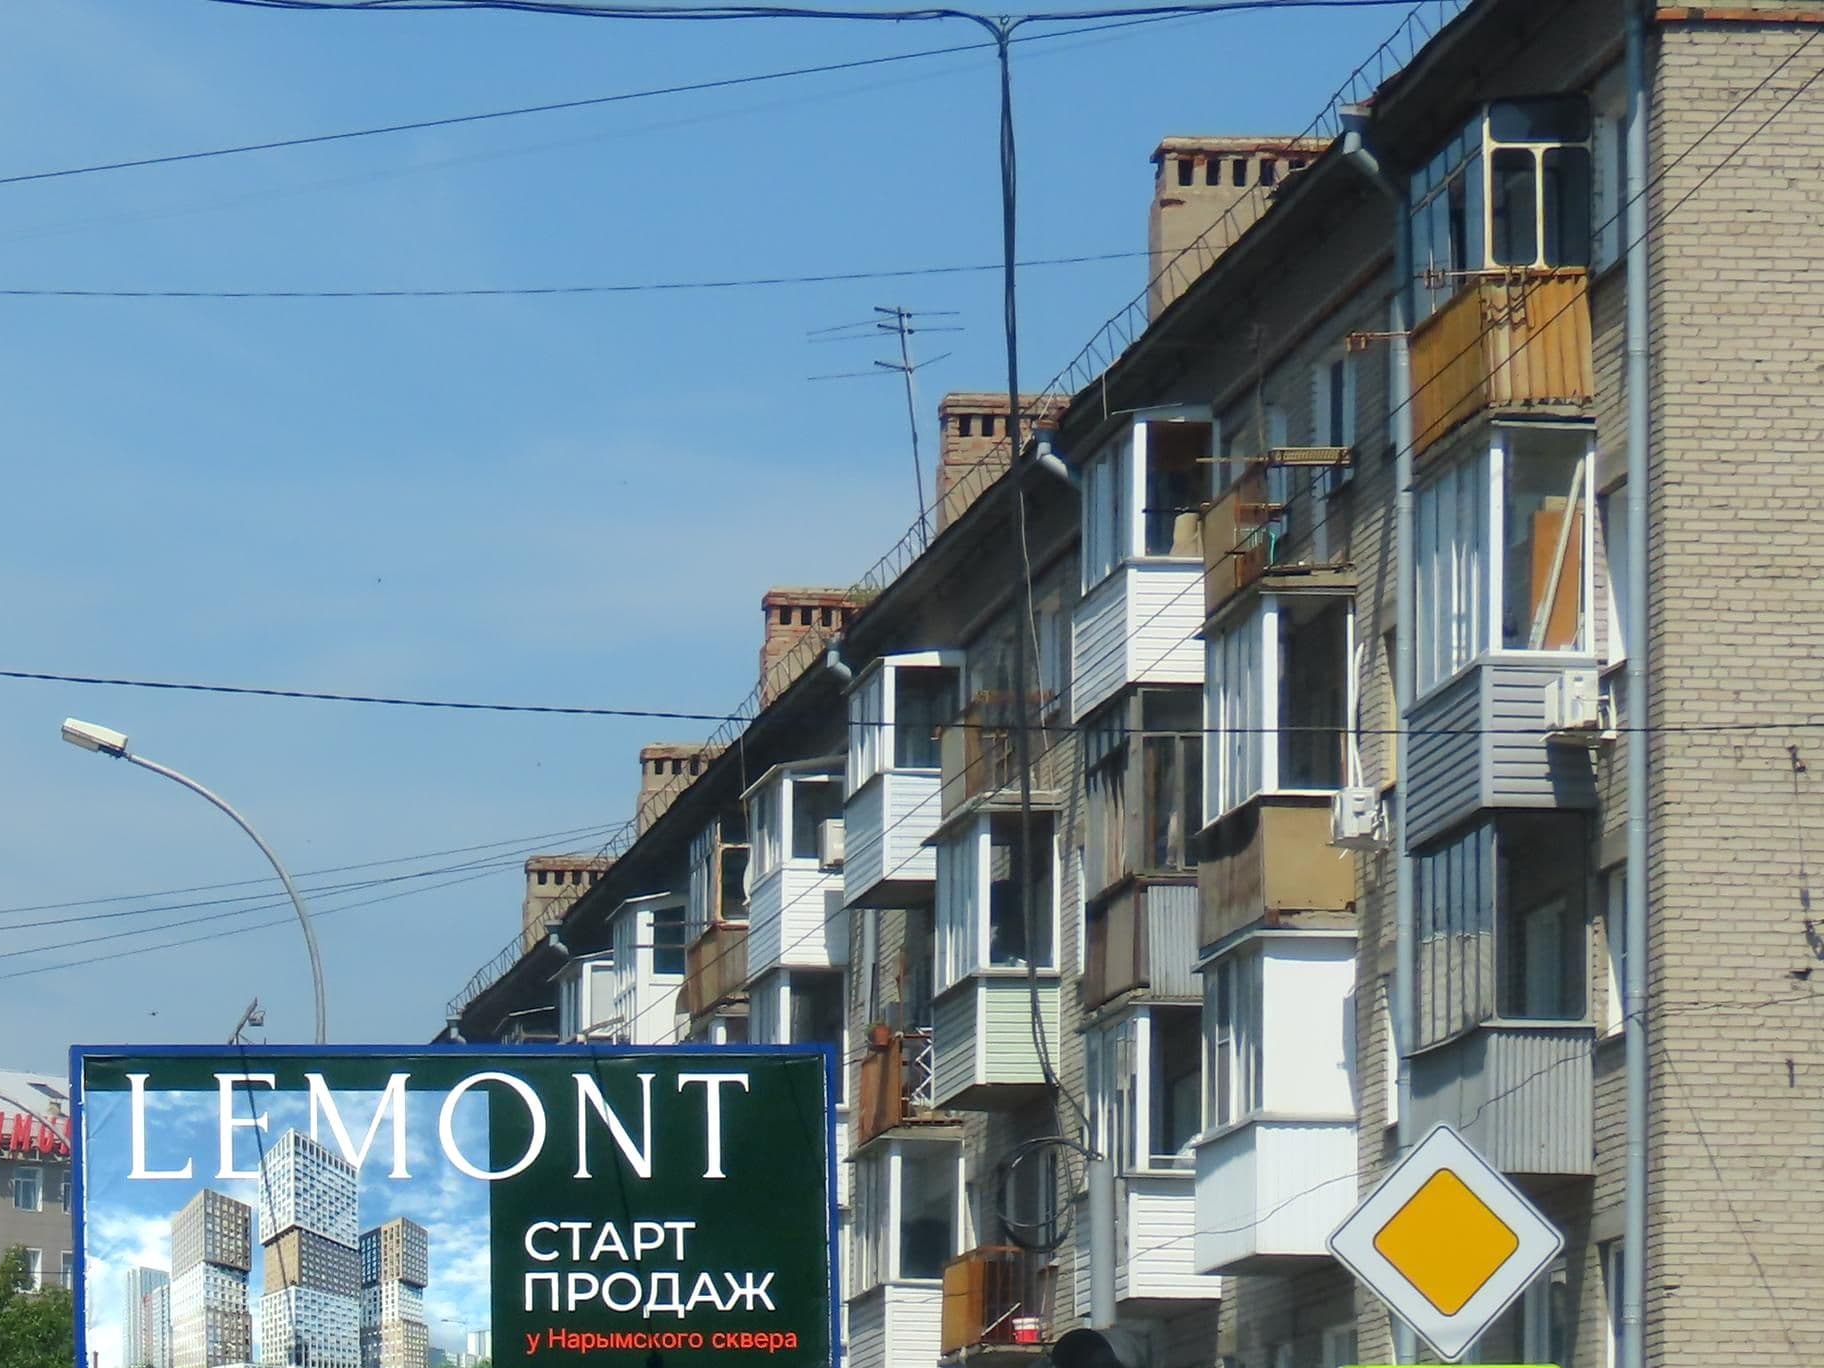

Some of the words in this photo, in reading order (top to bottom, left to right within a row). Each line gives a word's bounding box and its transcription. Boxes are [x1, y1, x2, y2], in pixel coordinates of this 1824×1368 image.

[125, 1071, 750, 1180] LEMONT
[524, 1220, 696, 1262] СТАРТ
[524, 1270, 776, 1319] ПРОДАЖ
[526, 1332, 541, 1354] у
[548, 1327, 704, 1353] Нарымского
[711, 1331, 798, 1353] сквера
